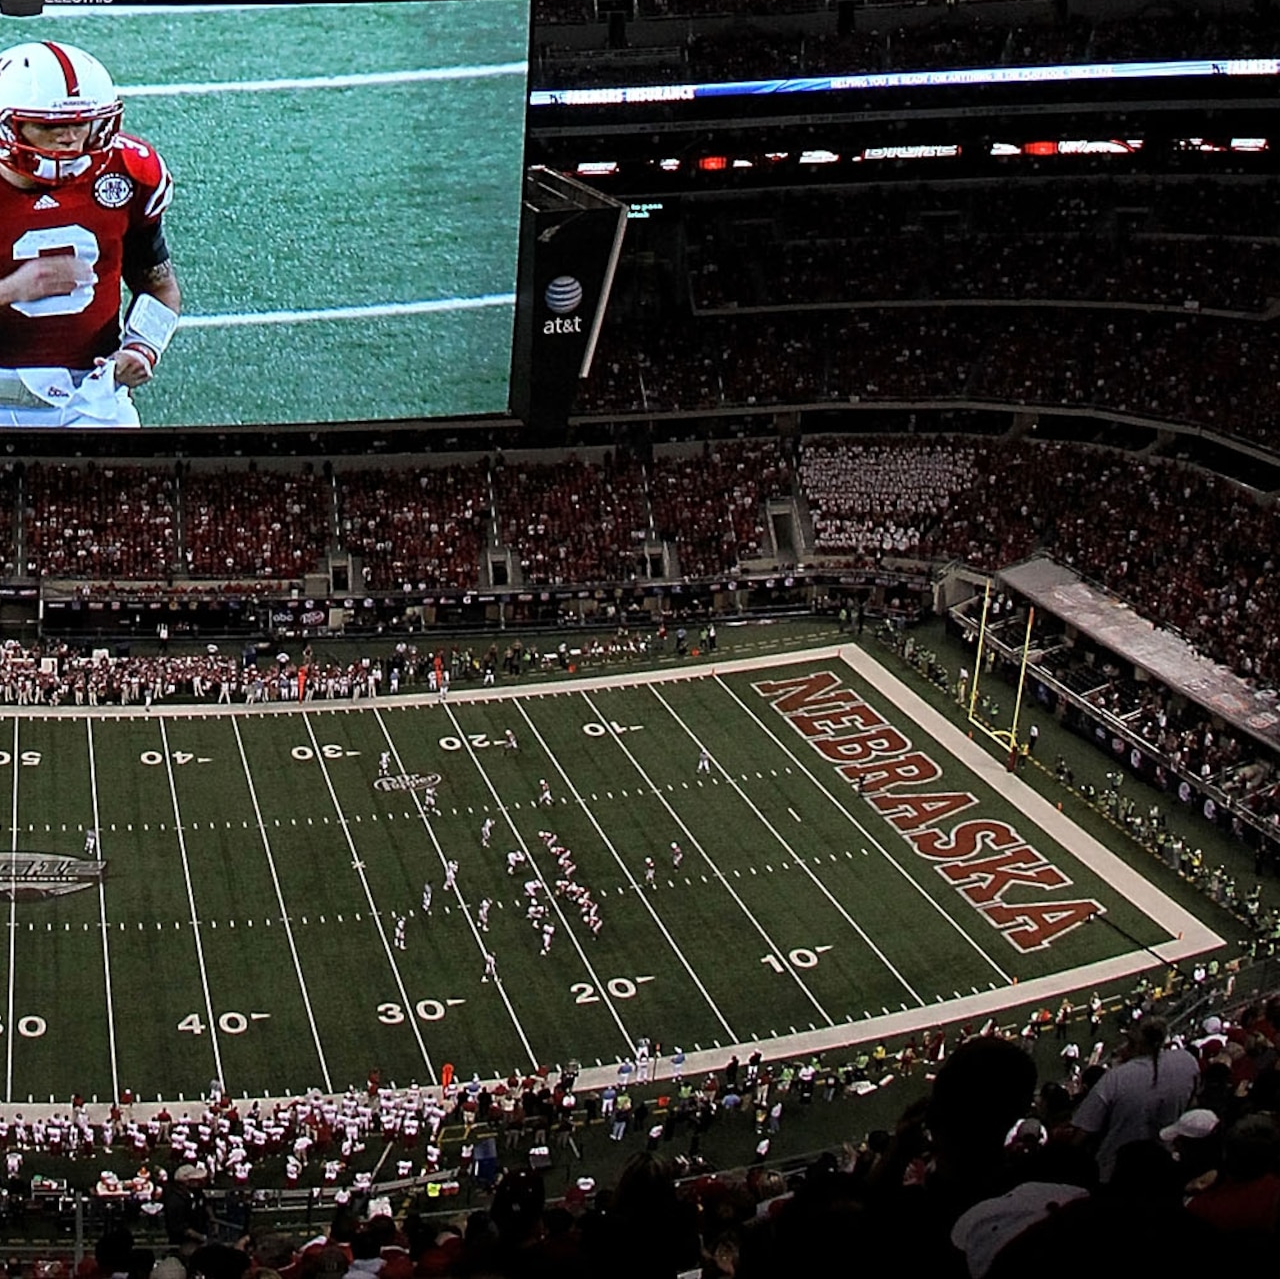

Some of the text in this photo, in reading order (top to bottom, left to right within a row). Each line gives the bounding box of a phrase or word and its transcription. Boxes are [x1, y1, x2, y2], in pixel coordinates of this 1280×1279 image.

[625, 85, 695, 103] INSURANCE
[10, 224, 99, 317] 3
[543, 316, 582, 334] at&t
[583, 721, 627, 737] 10
[291, 743, 343, 760] 30
[439, 734, 490, 751] 20
[140, 750, 194, 765] 40
[750, 671, 1107, 953] NEBRASKA
[760, 948, 818, 973] 10
[570, 977, 637, 1004] 20
[377, 999, 445, 1024] 30
[177, 1012, 248, 1034] 40
